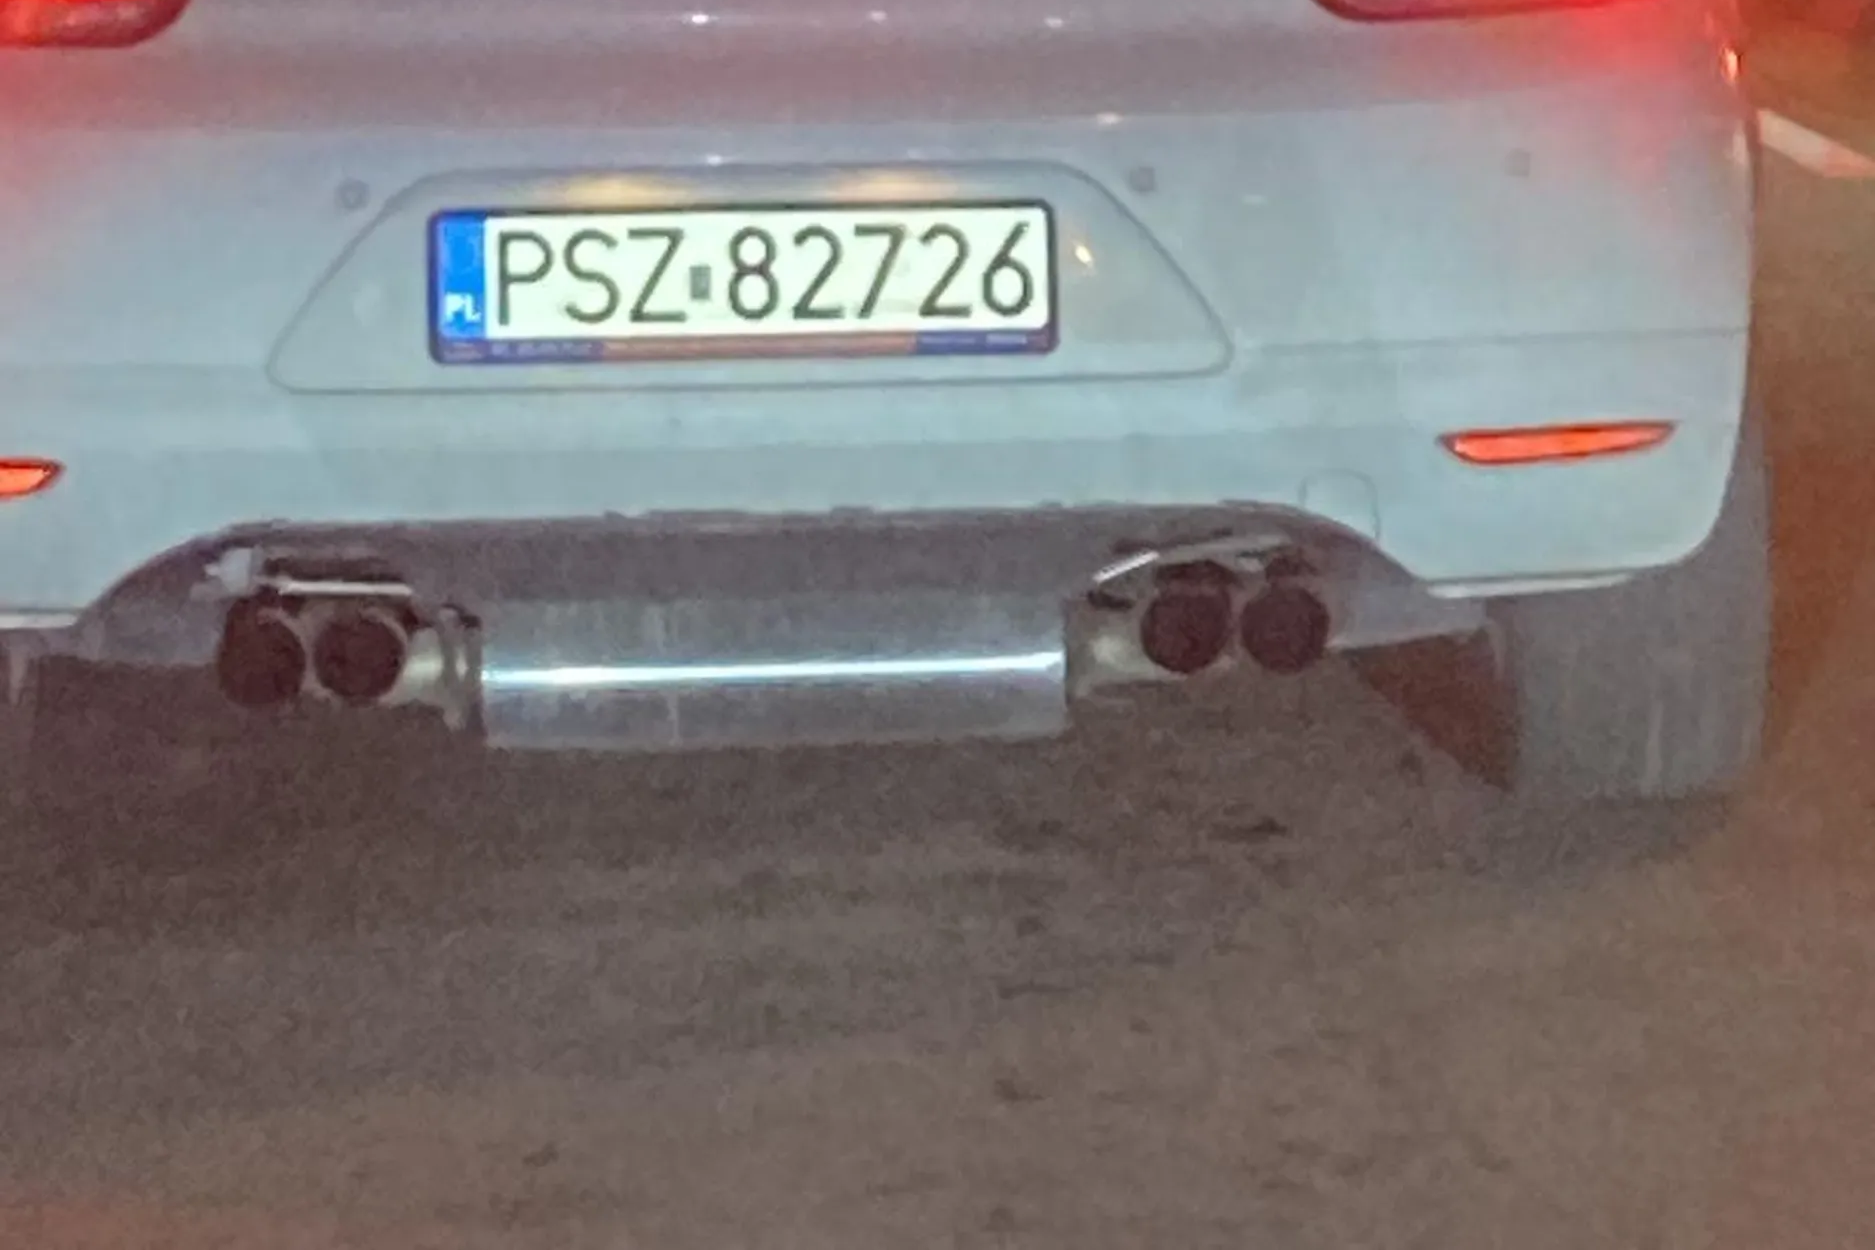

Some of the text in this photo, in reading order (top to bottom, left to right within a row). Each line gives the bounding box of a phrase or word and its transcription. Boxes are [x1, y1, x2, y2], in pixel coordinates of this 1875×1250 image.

[498, 221, 1034, 326] PSZ 82726
[444, 293, 481, 323] PL
